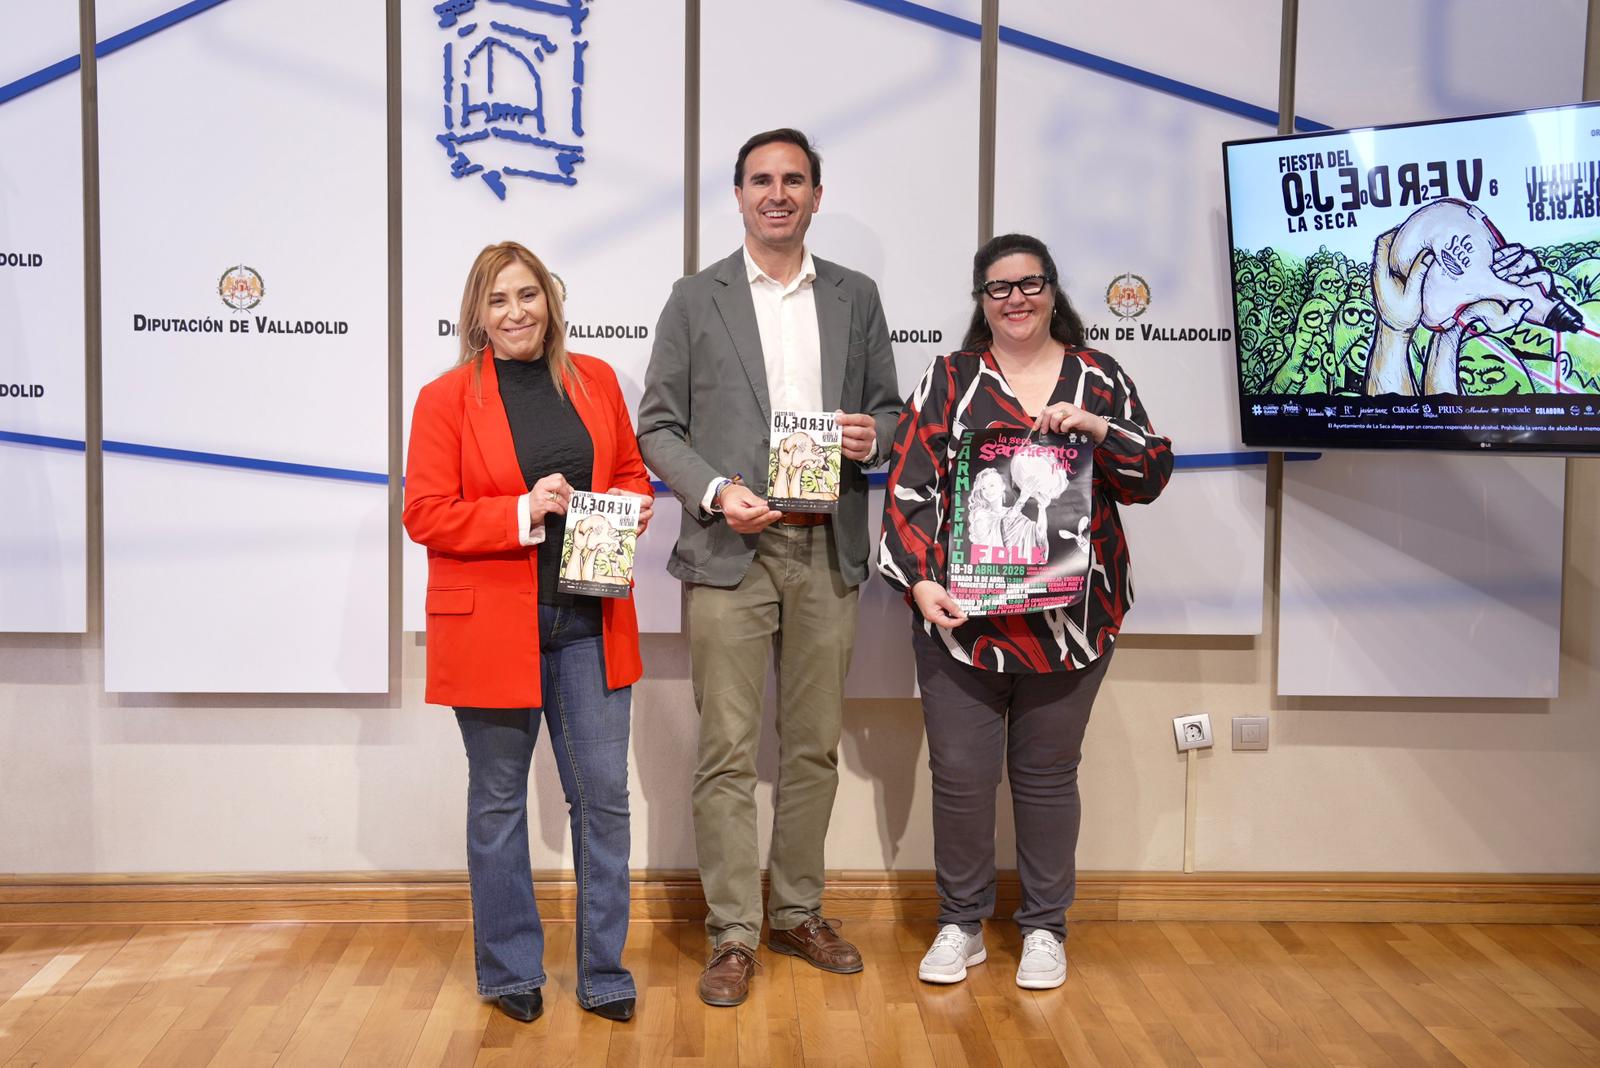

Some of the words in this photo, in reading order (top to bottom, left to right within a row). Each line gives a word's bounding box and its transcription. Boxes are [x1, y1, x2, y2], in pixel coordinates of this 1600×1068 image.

[1279, 153, 1324, 173] FIESTA
[1327, 150, 1353, 168] DEL
[1288, 216, 1308, 233] LA
[1314, 212, 1358, 231] SECA
[0, 253, 43, 267] DOLID
[134, 314, 223, 332] DIPUTACIÓN
[256, 316, 348, 334] VALLADOLID
[564, 321, 648, 339] ALLADOLID
[891, 330, 942, 343] ADOLID
[1141, 323, 1231, 341] VALLADOLID
[0, 384, 44, 398] DOLID
[1439, 406, 1463, 414] PRIUS
[1502, 405, 1531, 414] menade
[1535, 407, 1565, 415] COLABORA
[951, 564, 973, 575] 18-19
[975, 565, 1000, 575] ABRIL
[1003, 565, 1025, 576] 2026
